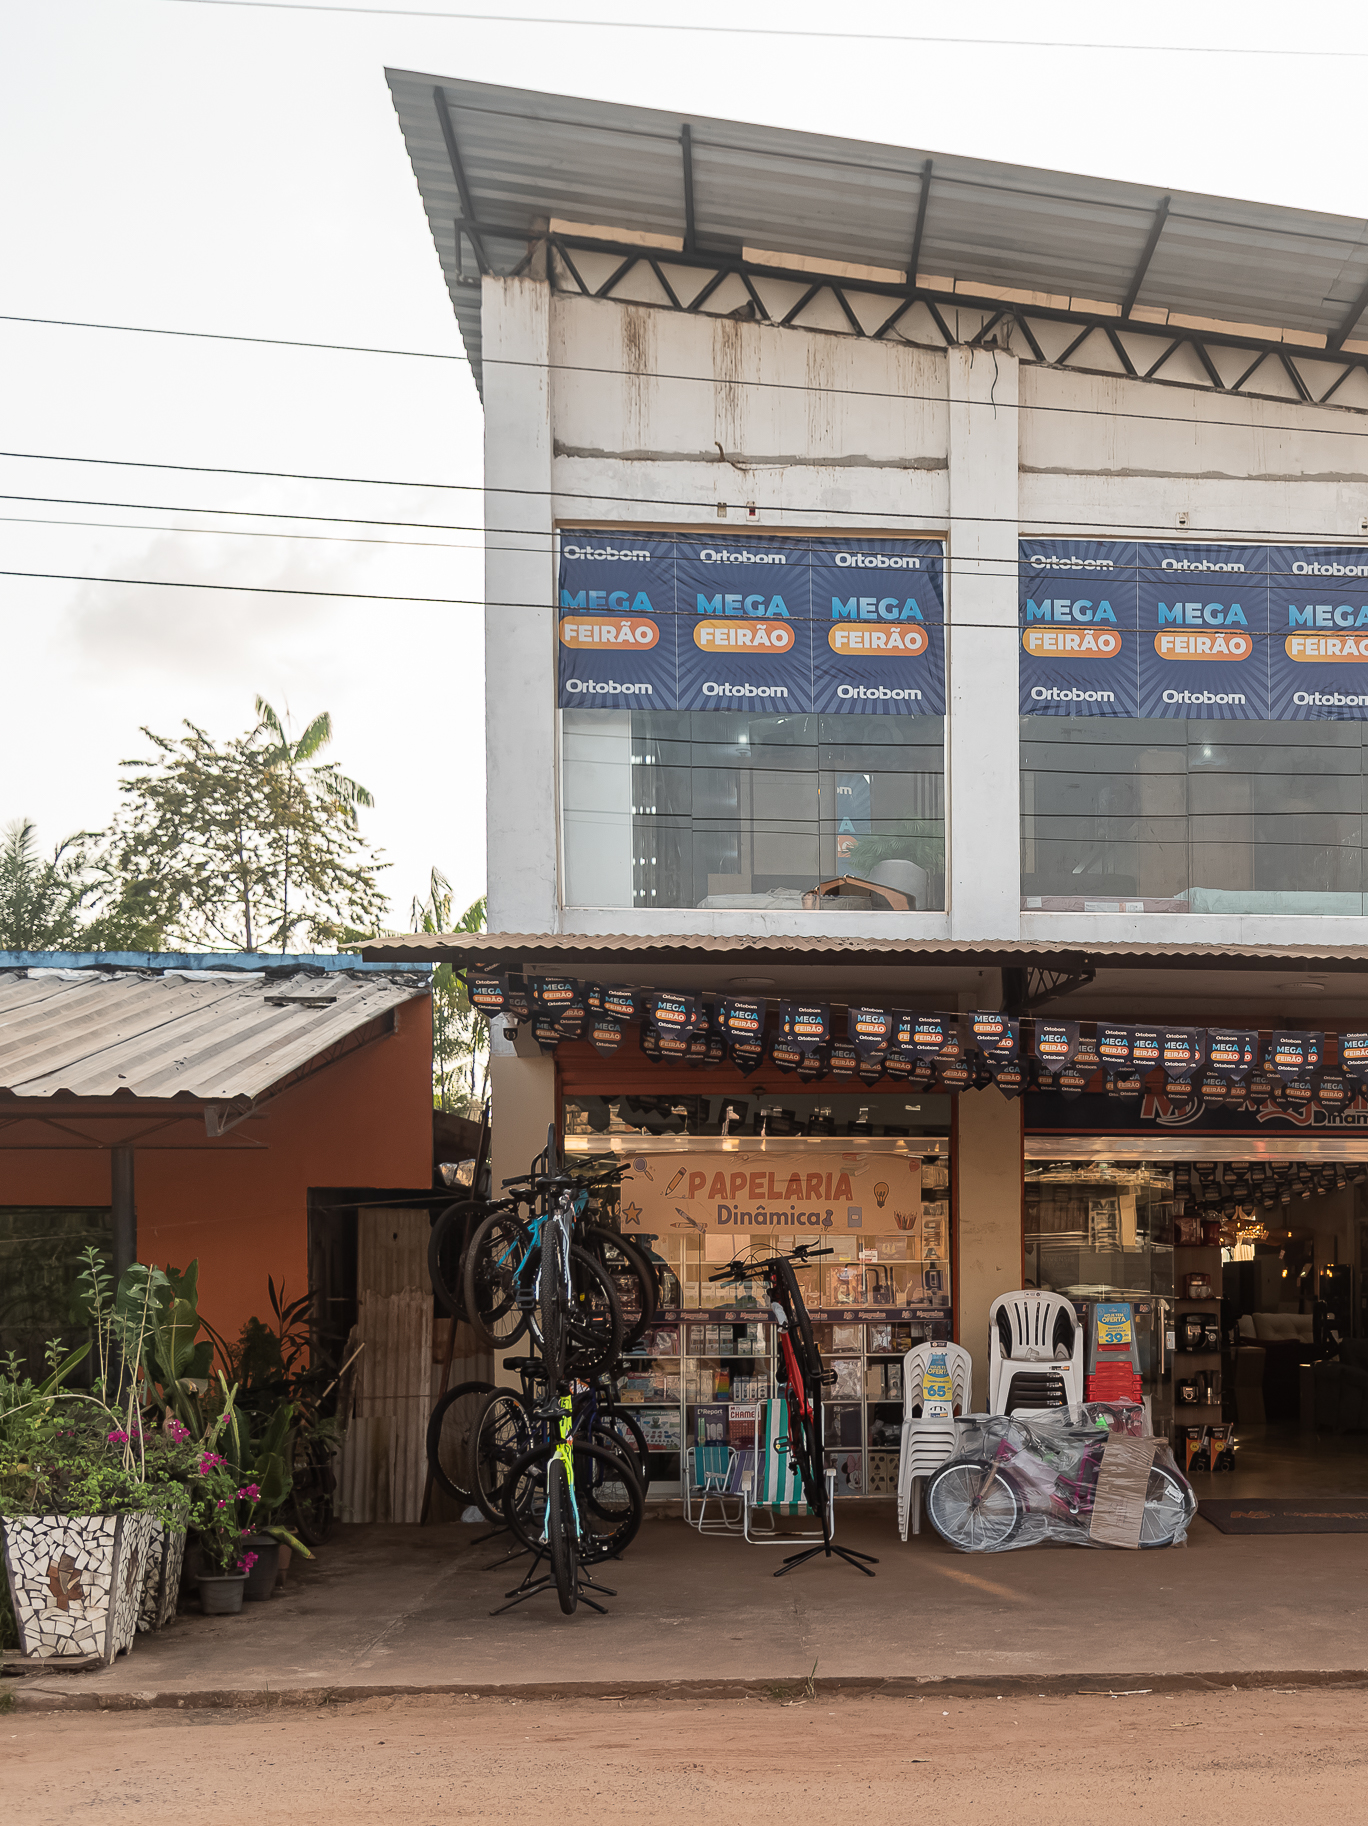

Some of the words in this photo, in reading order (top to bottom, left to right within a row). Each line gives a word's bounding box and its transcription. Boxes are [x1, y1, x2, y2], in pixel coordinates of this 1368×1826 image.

[563, 545, 651, 562] Ortobom
[700, 549, 786, 565] Ortobom
[835, 552, 920, 569] Ortobom
[1030, 555, 1114, 571] Ortobom
[1161, 558, 1245, 573] Ortobom
[560, 590, 654, 611] MEGA
[696, 593, 791, 617] MEGA
[831, 597, 923, 620] MEGA
[1026, 599, 1117, 622] MEGA
[1158, 602, 1248, 625] MEGA
[564, 621, 653, 644] FEIRÃO
[700, 624, 789, 648] FEIRÃO
[834, 627, 923, 650] FEIRÃO
[1029, 630, 1115, 651] FEIRÃO
[1161, 633, 1247, 654] FEIRÃO
[565, 678, 653, 695] Ortobom
[702, 681, 788, 698] Ortobom
[837, 684, 922, 700] Ortobom
[1030, 686, 1115, 702] Ortobom
[1162, 689, 1246, 705] Ortobom
[605, 996, 634, 1006] MEGA
[658, 1002, 686, 1012] MEGA
[658, 1012, 685, 1021] FEIRÃO
[730, 1010, 758, 1020] MEGA
[858, 1015, 885, 1023] MEGA
[730, 1020, 757, 1028] FEIRÃO
[796, 1024, 822, 1032] FEIRÃO
[858, 1024, 884, 1032] FEIRÃO
[916, 1034, 942, 1042] FEIRÃO
[1102, 1038, 1128, 1046] MEGA
[1102, 1046, 1128, 1054] FEIRÃO
[1276, 1046, 1302, 1054] MEGA
[1276, 1055, 1302, 1063] FEIRÃO
[689, 1171, 853, 1201] PAPELARIA
[717, 1204, 821, 1225] Dinâmica
[1105, 1333, 1123, 1343] 39
[928, 1385, 946, 1397] 65
